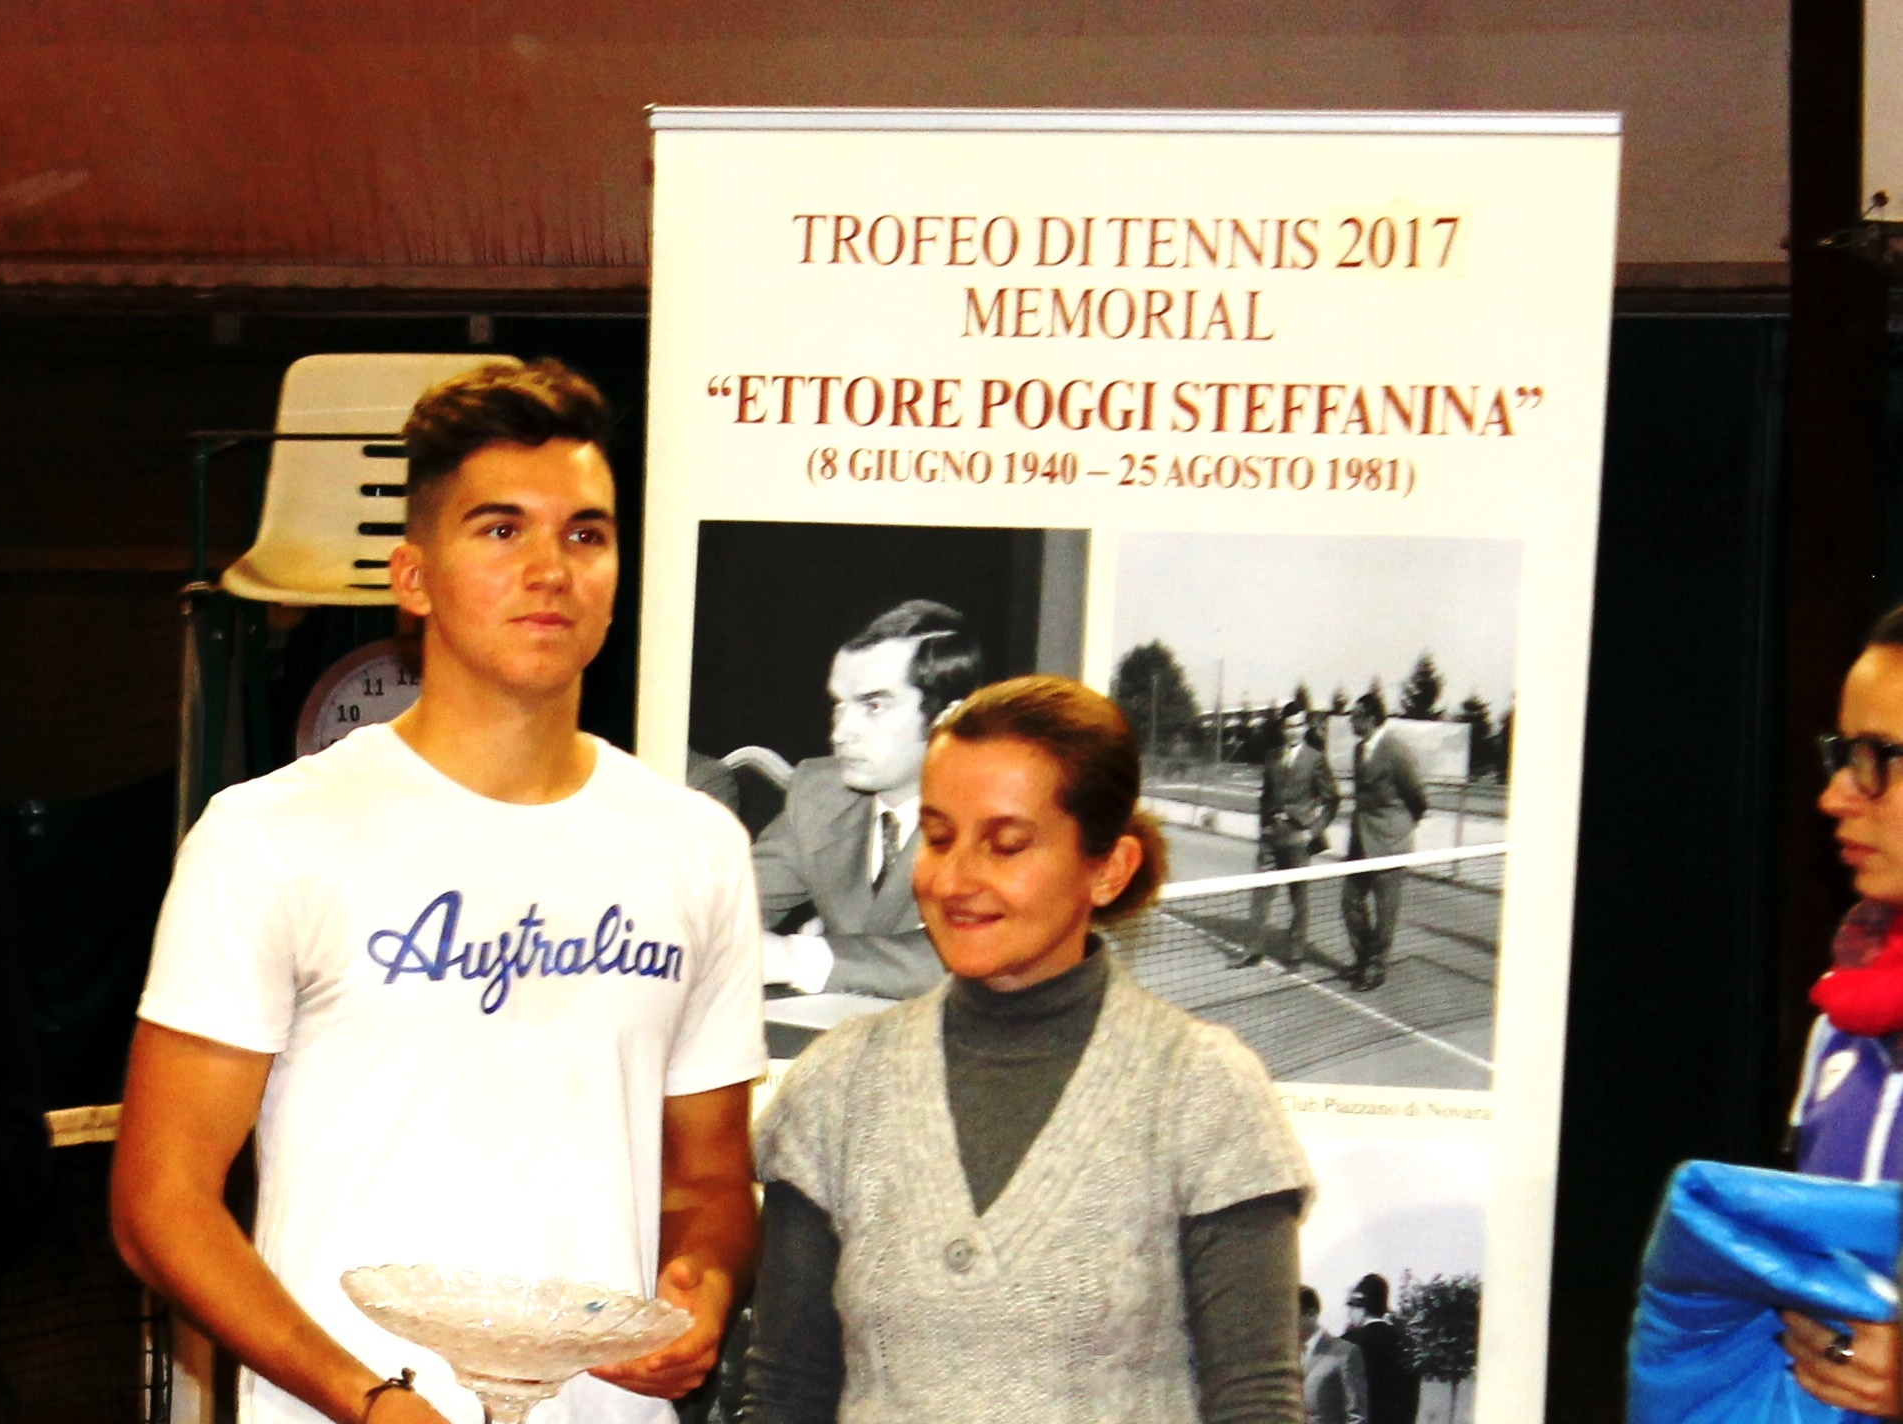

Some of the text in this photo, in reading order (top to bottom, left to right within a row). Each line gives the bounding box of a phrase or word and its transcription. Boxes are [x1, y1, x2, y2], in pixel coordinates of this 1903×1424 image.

[792, 213, 1461, 270] TROFEO DI TENNIS 2017
[959, 287, 1276, 341] MEMORIAL
[976, 378, 1159, 432] POGGI
[806, 446, 838, 487] (8
[848, 448, 993, 484] GIUGNO
[1004, 451, 1079, 486] 1940
[1117, 453, 1158, 487] 25
[1163, 454, 1315, 491] AGOSTO
[1325, 456, 1417, 499] 1981)
[337, 703, 361, 723] 10
[362, 677, 385, 697] 11
[366, 889, 684, 1015] Australian
